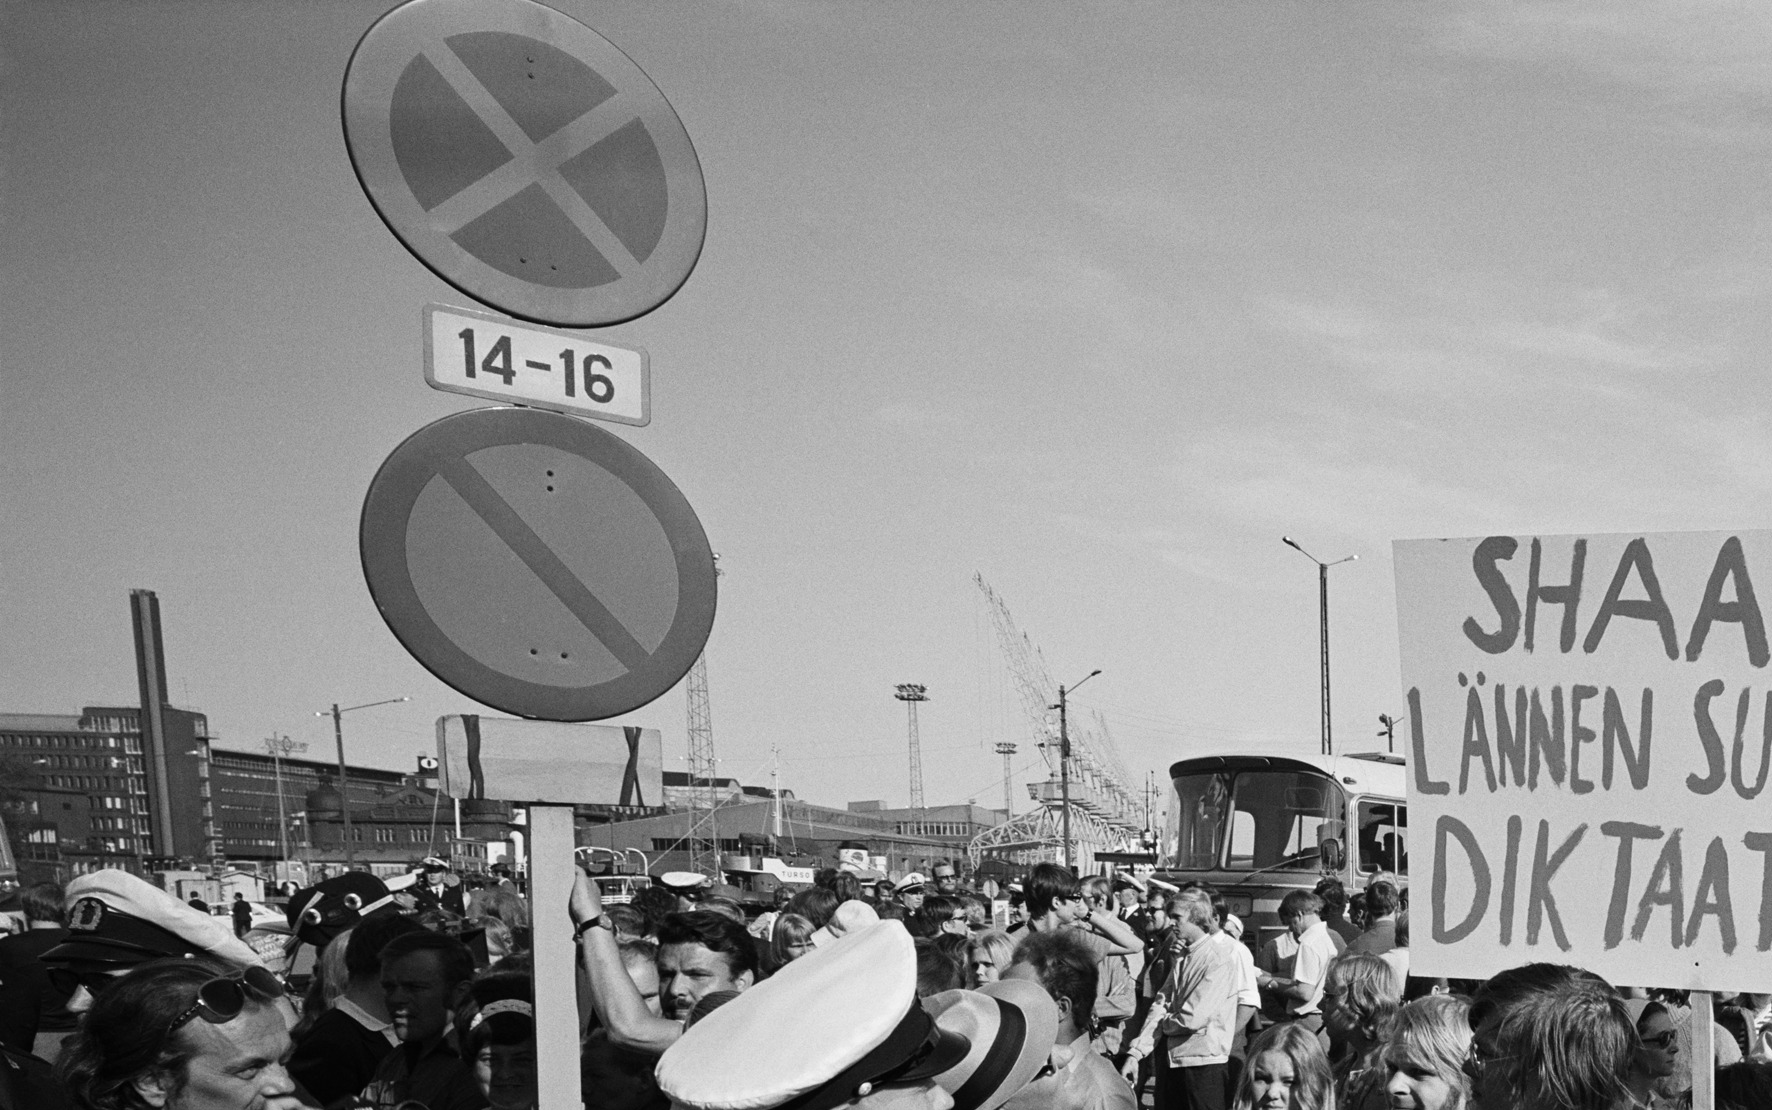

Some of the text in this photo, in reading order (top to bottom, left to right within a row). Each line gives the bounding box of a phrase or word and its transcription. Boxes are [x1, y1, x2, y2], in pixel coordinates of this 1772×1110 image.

[458, 327, 615, 404] 14-16
[1406, 671, 1653, 796] LÄNNEN
[782, 870, 810, 879] TURSO
